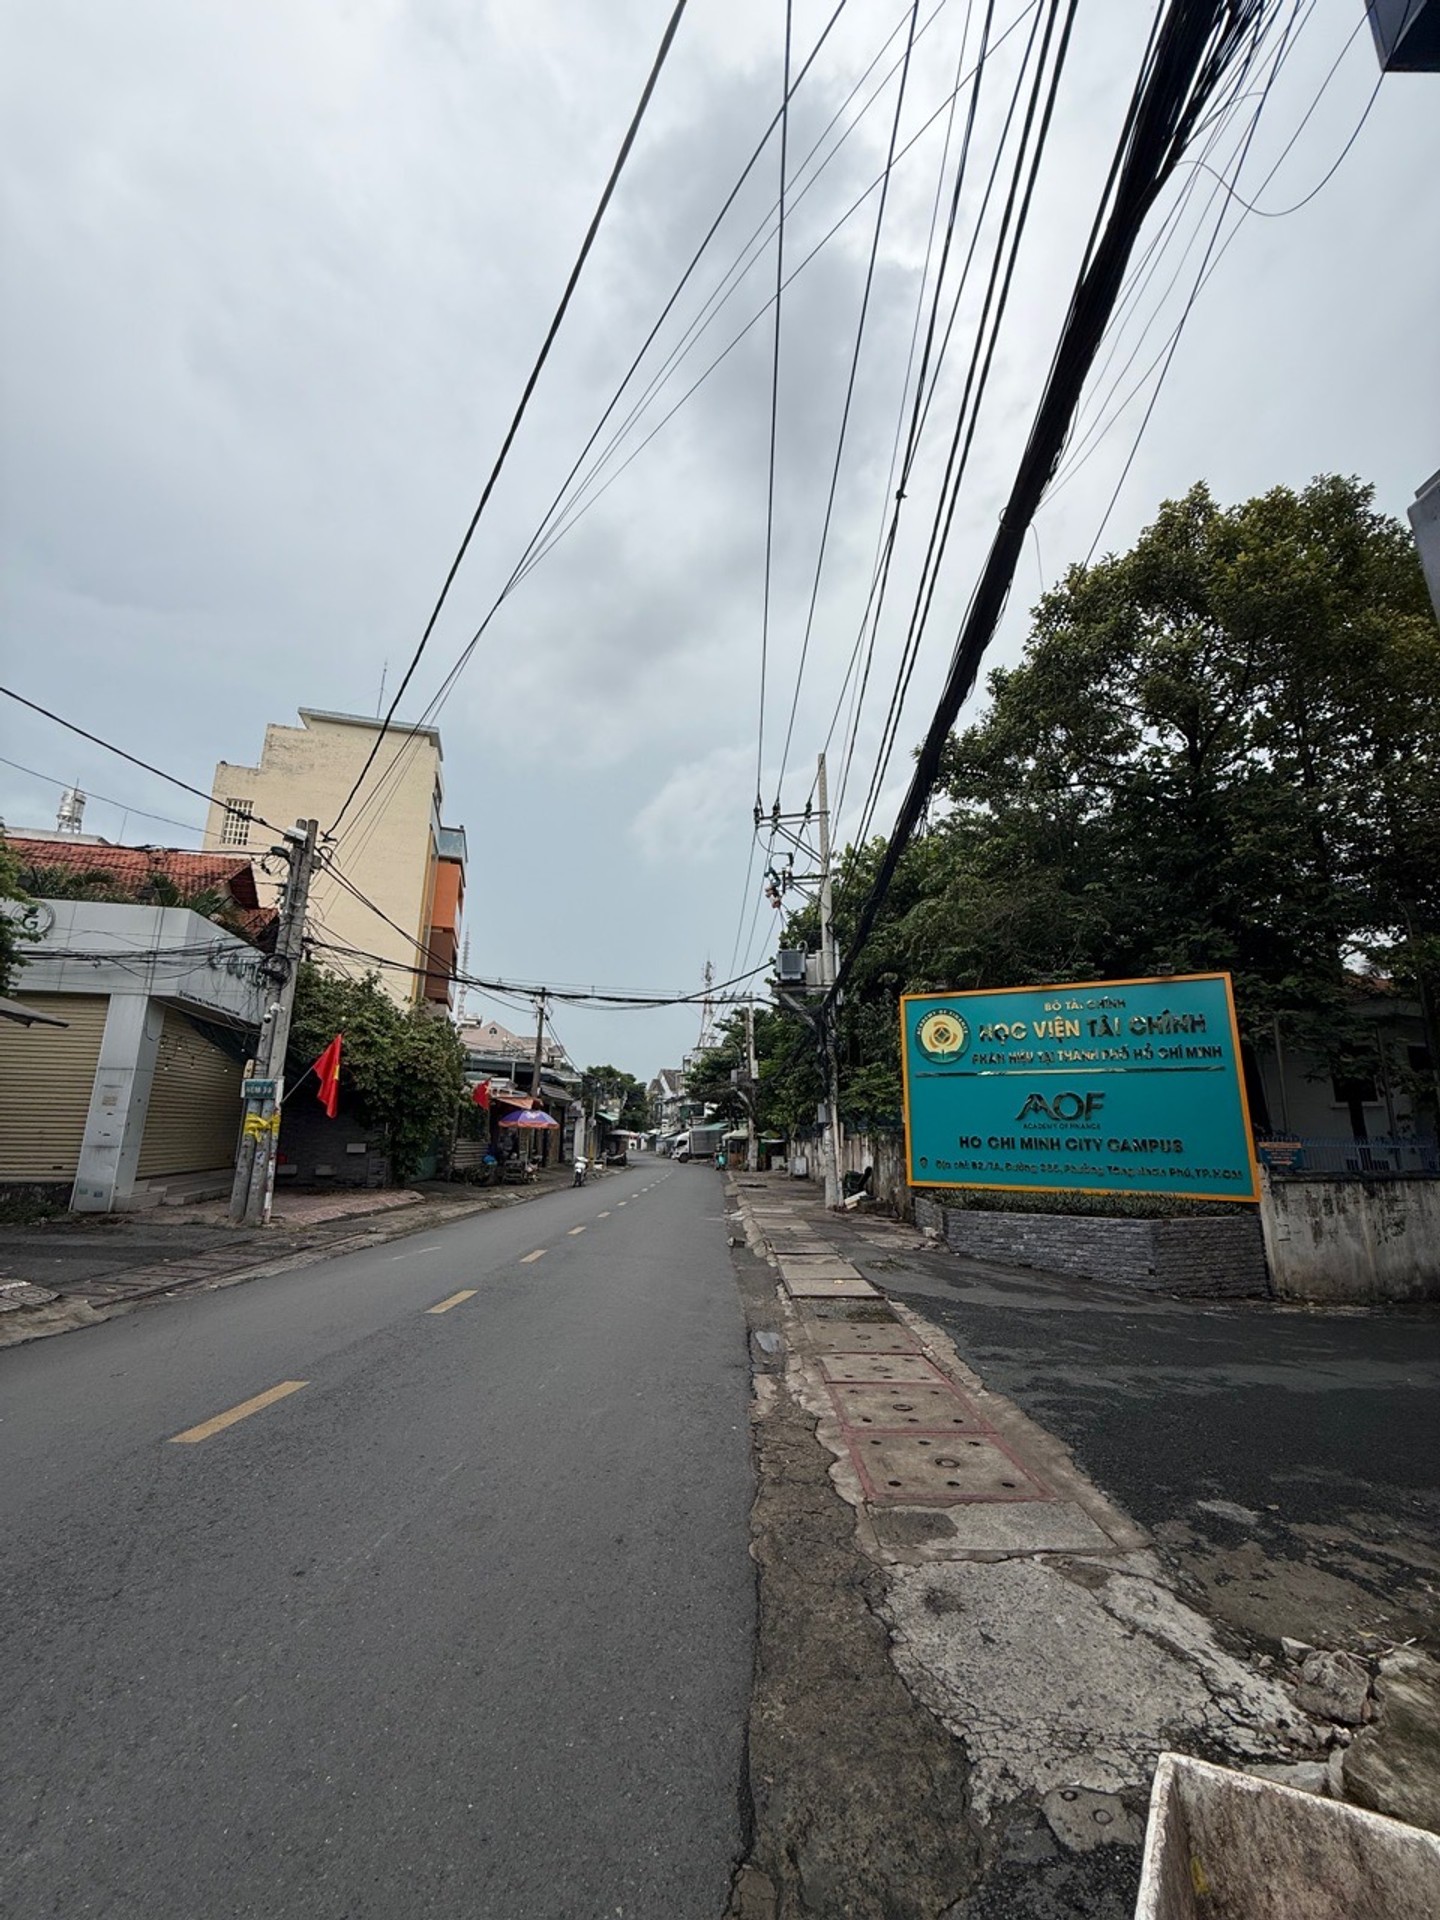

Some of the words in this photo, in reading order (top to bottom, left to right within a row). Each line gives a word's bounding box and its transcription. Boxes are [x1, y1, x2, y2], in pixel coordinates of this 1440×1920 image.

[1044, 1000, 1062, 1013] BỘ
[1087, 996, 1126, 1010] CHÍNH
[980, 1022, 1027, 1046] HỌC
[1033, 1015, 1080, 1043] VIỆN
[1087, 1014, 1121, 1037] TÀI
[1129, 1009, 1206, 1036] CHÍNH
[1057, 1047, 1099, 1063] THÀNH
[1101, 1044, 1129, 1061] PHỐ
[1158, 1044, 1183, 1059] CHÍ
[1186, 1045, 1222, 1058] MINH
[1015, 1090, 1105, 1121] AOF
[1023, 1122, 1057, 1130] ACADEMY
[1059, 1122, 1068, 1130] OF
[1069, 1121, 1101, 1130] FINANCE
[959, 1136, 982, 1149] HO
[987, 1136, 1015, 1150] CHI
[1020, 1136, 1061, 1151] MINH
[1065, 1137, 1102, 1151] CITY
[1107, 1137, 1184, 1153] CAMPUS
